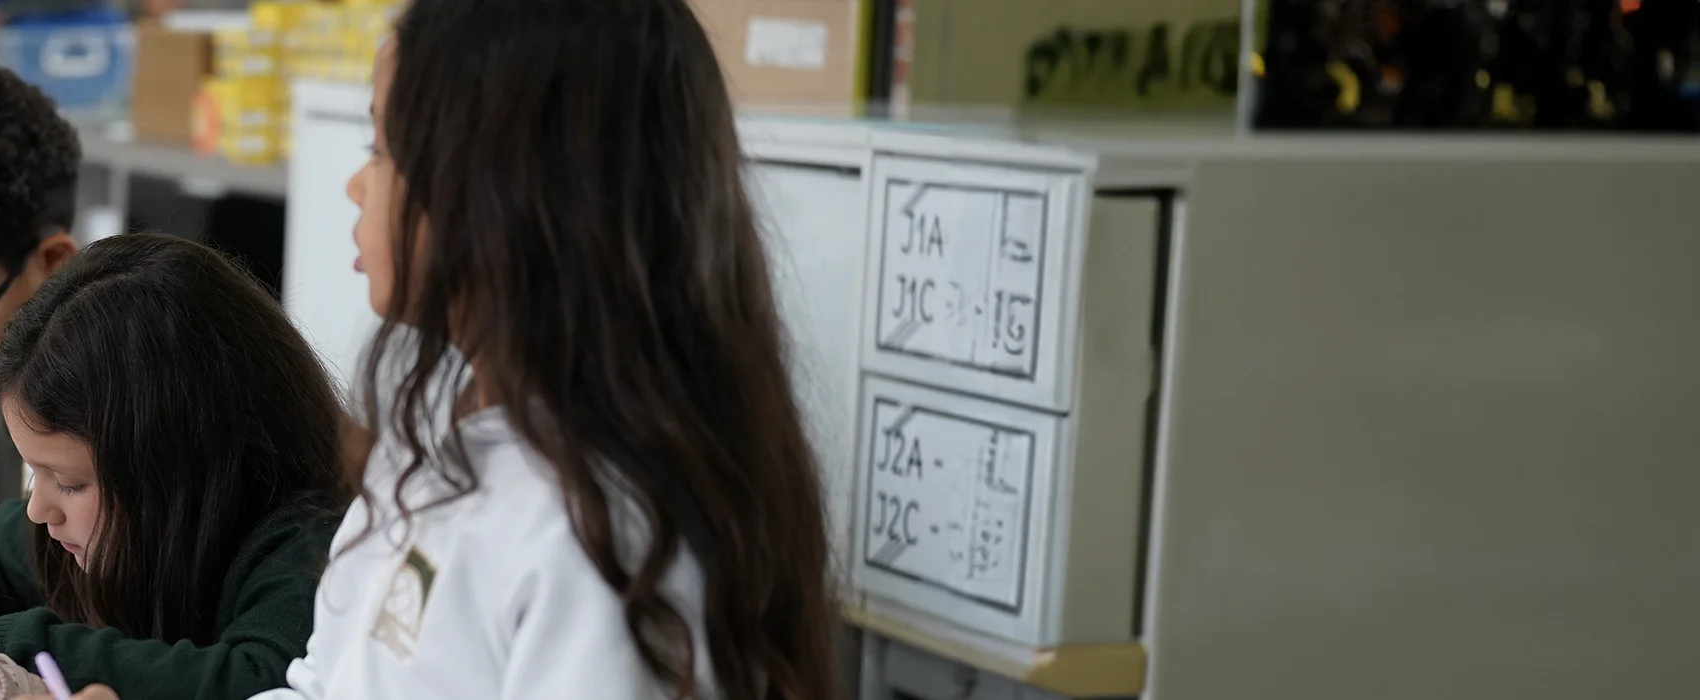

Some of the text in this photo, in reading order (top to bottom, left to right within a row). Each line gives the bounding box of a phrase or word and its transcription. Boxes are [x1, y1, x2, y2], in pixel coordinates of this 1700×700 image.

[902, 209, 943, 257] J1A
[892, 274, 936, 323] J1C
[877, 427, 922, 479] J2A
[873, 491, 919, 545] J2C
